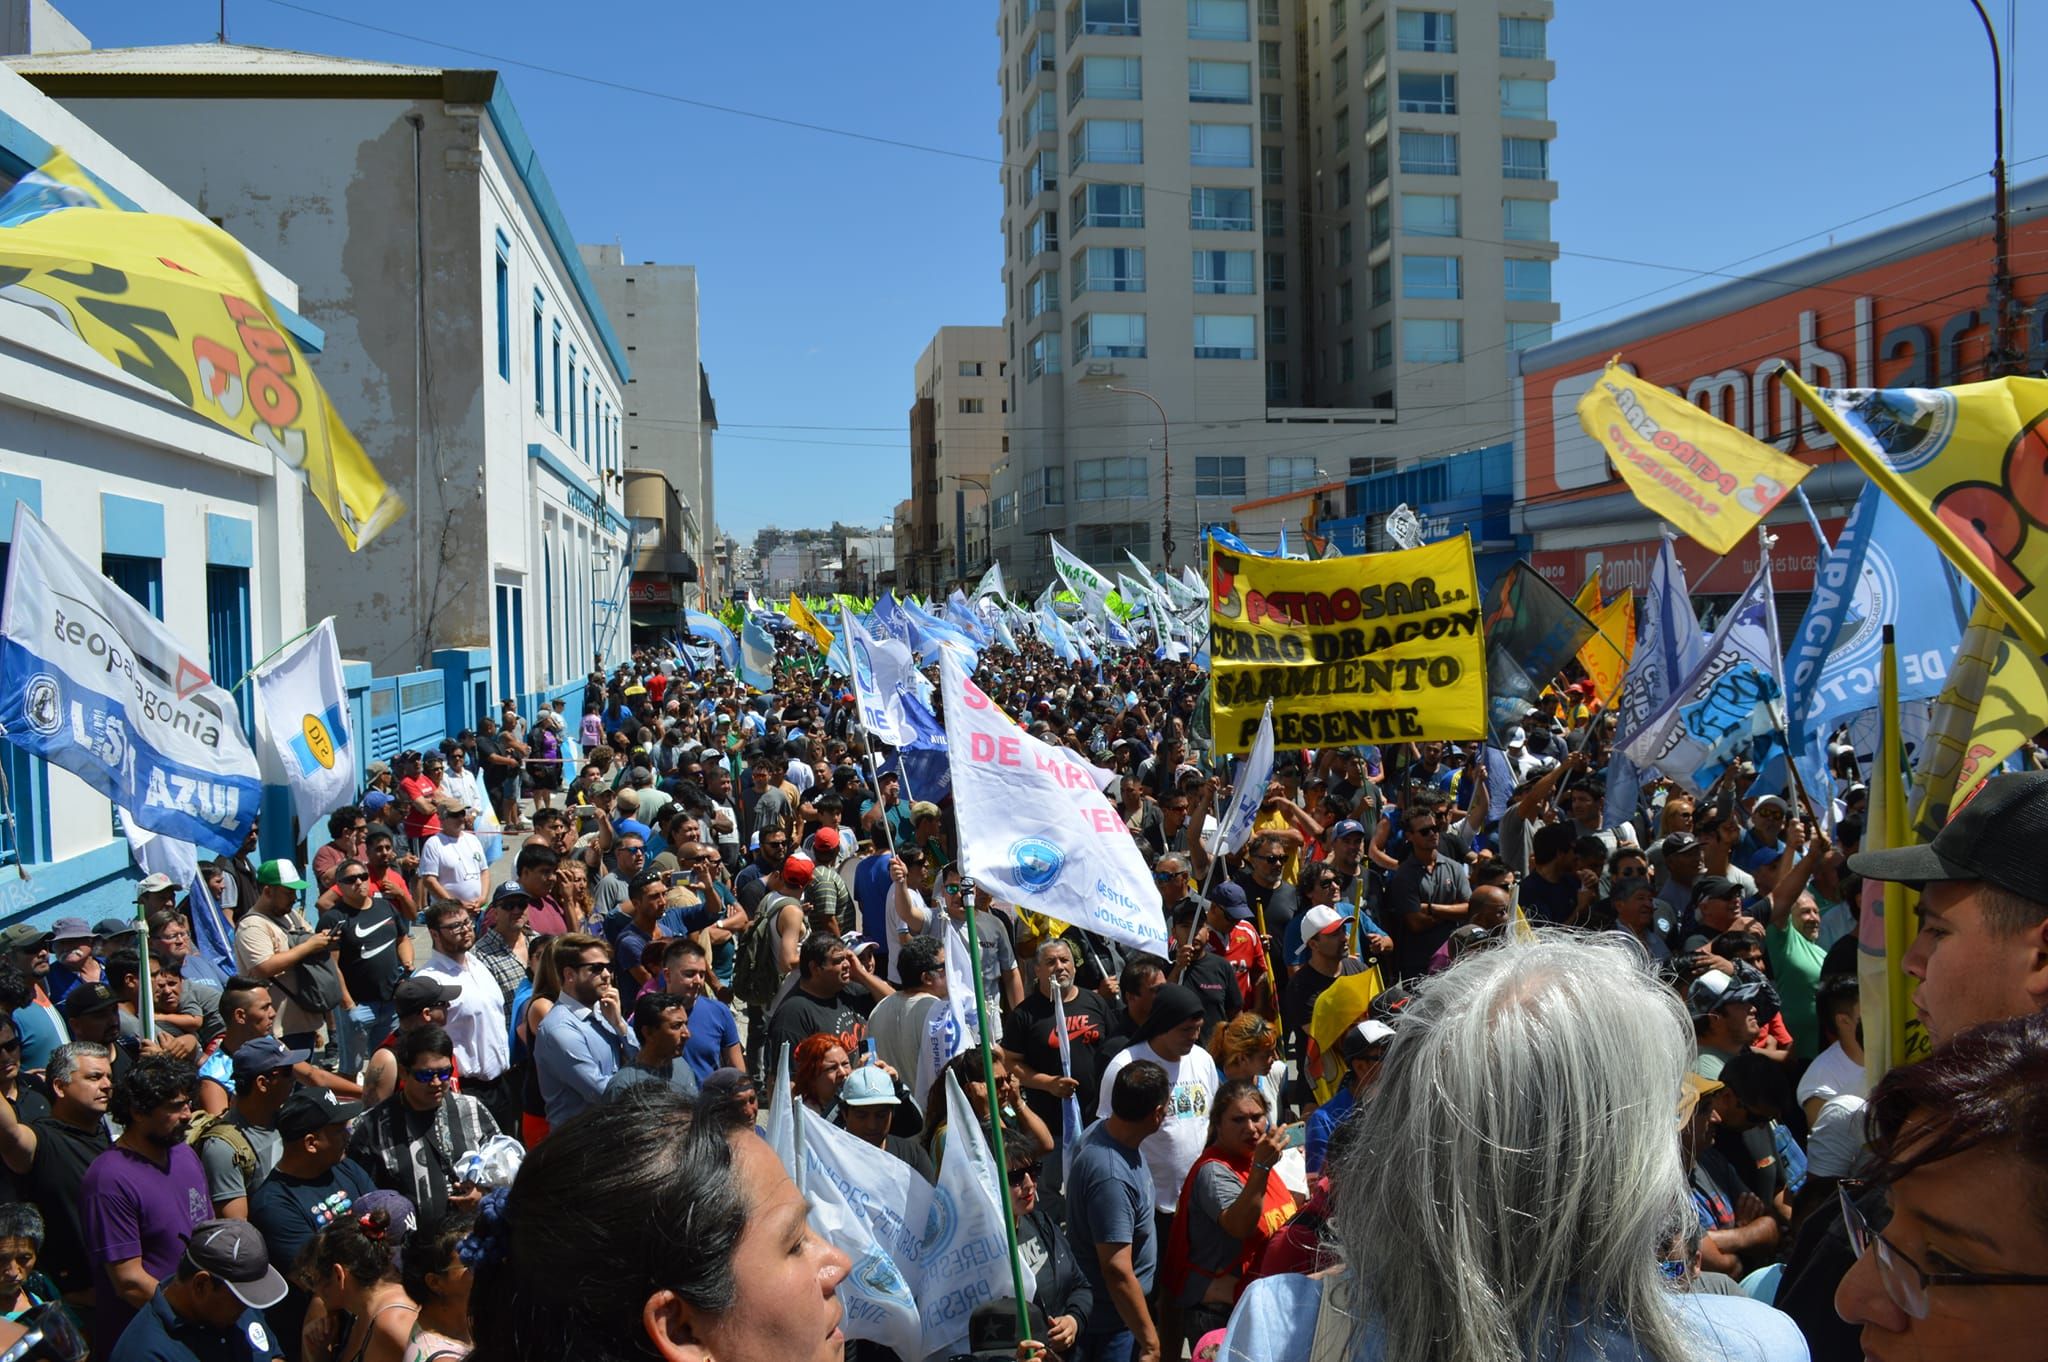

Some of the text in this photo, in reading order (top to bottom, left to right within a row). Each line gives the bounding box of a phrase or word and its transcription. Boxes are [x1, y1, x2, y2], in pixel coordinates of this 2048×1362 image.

[1055, 556, 1098, 590] SMATA
[1312, 609, 1478, 663] DRAGON
[1214, 656, 1459, 707] SARMIENTO
[1239, 708, 1424, 747] PESENTE
[971, 733, 1021, 767] DE
[145, 766, 240, 831] AZUL
[1095, 907, 1135, 933] JORGE
